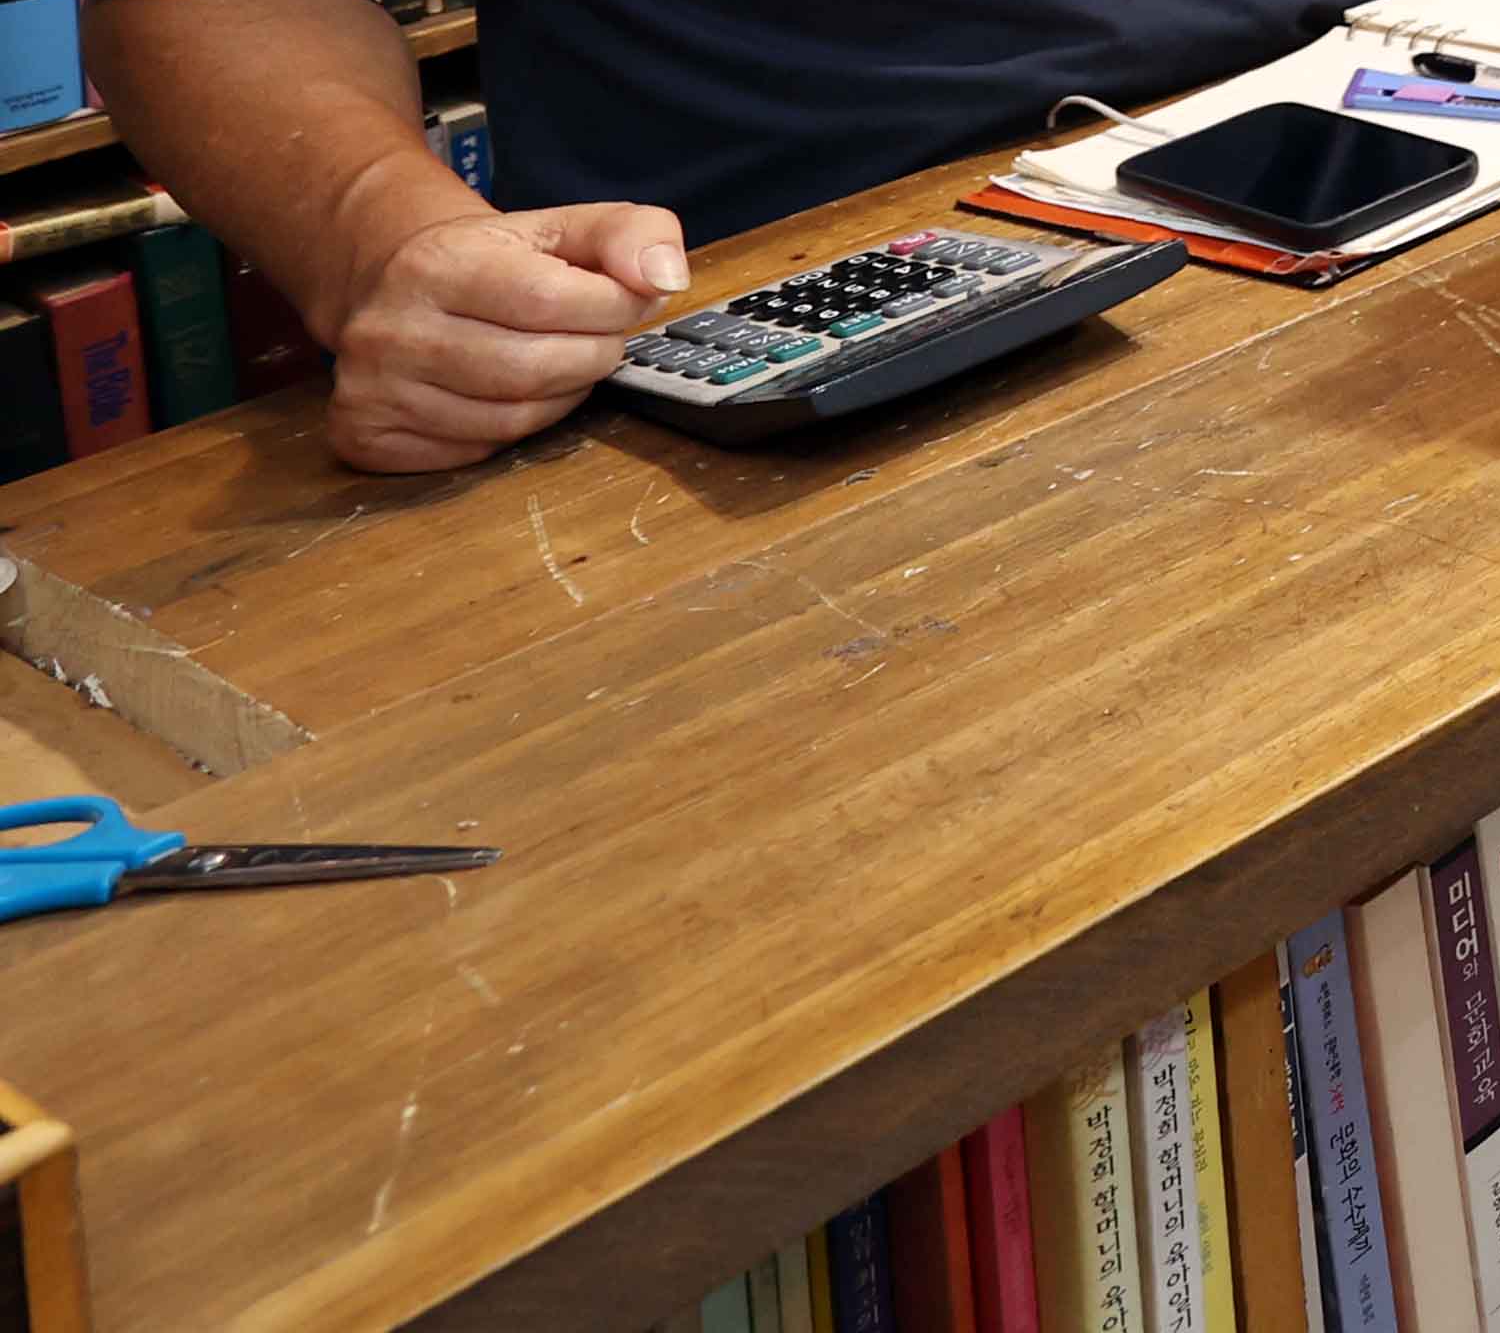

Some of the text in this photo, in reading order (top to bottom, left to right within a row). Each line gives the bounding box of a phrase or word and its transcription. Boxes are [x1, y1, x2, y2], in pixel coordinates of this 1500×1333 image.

[1447, 871, 1498, 1106] 미디어와 문화교육
[1087, 1106, 1116, 1182] 박정희
[1330, 1120, 1362, 1187] 문화의
[1094, 1184, 1123, 1280] 할머니의
[1153, 1064, 1194, 1333] 박정희 할머니의 육아일기
[1340, 1184, 1373, 1265] 수수께끼
